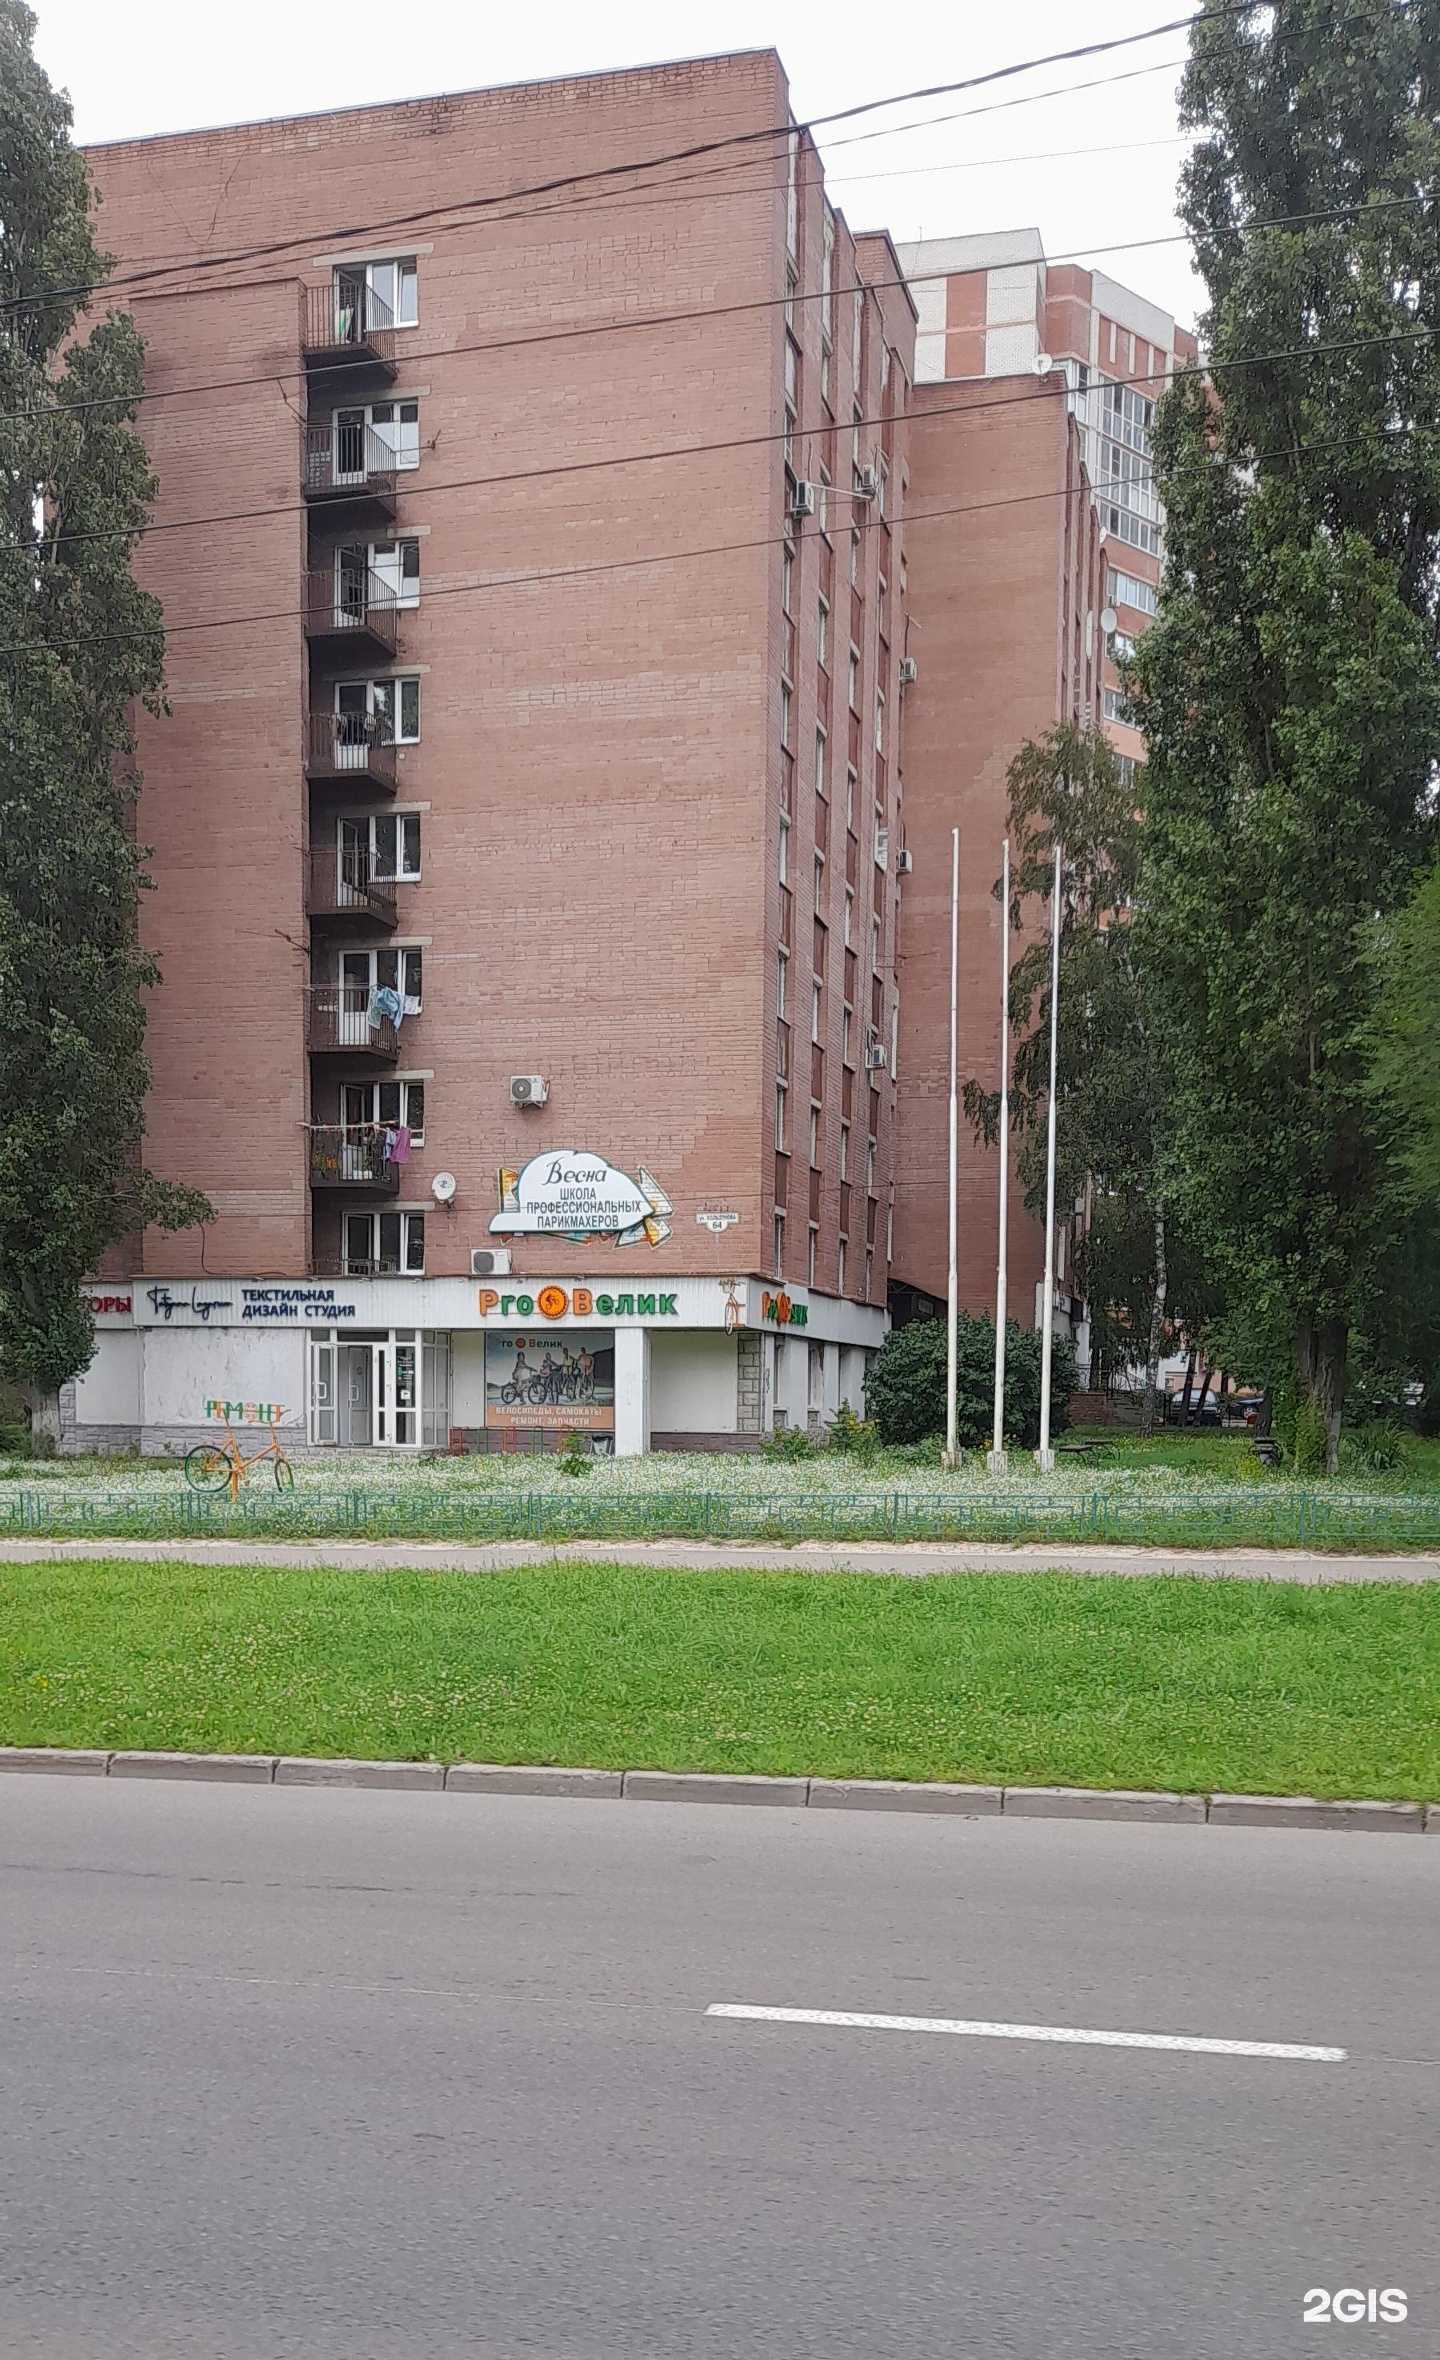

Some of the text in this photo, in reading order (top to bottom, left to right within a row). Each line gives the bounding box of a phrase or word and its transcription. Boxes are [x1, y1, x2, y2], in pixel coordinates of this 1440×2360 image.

[541, 1157, 607, 1185] Весна
[560, 1187, 596, 1200] ШКОЛА
[527, 1200, 641, 1214] ПРОФЕССИОНАЛЬНЫХ
[537, 1215, 619, 1228] ПАРИКМАХЕРОВ
[241, 1289, 335, 1301] ТЕКСТИЛЬНАЯ
[572, 1288, 678, 1317] Велик
[242, 1303, 298, 1320] ДИЗАЙН
[304, 1304, 356, 1319] СТУДИЯ
